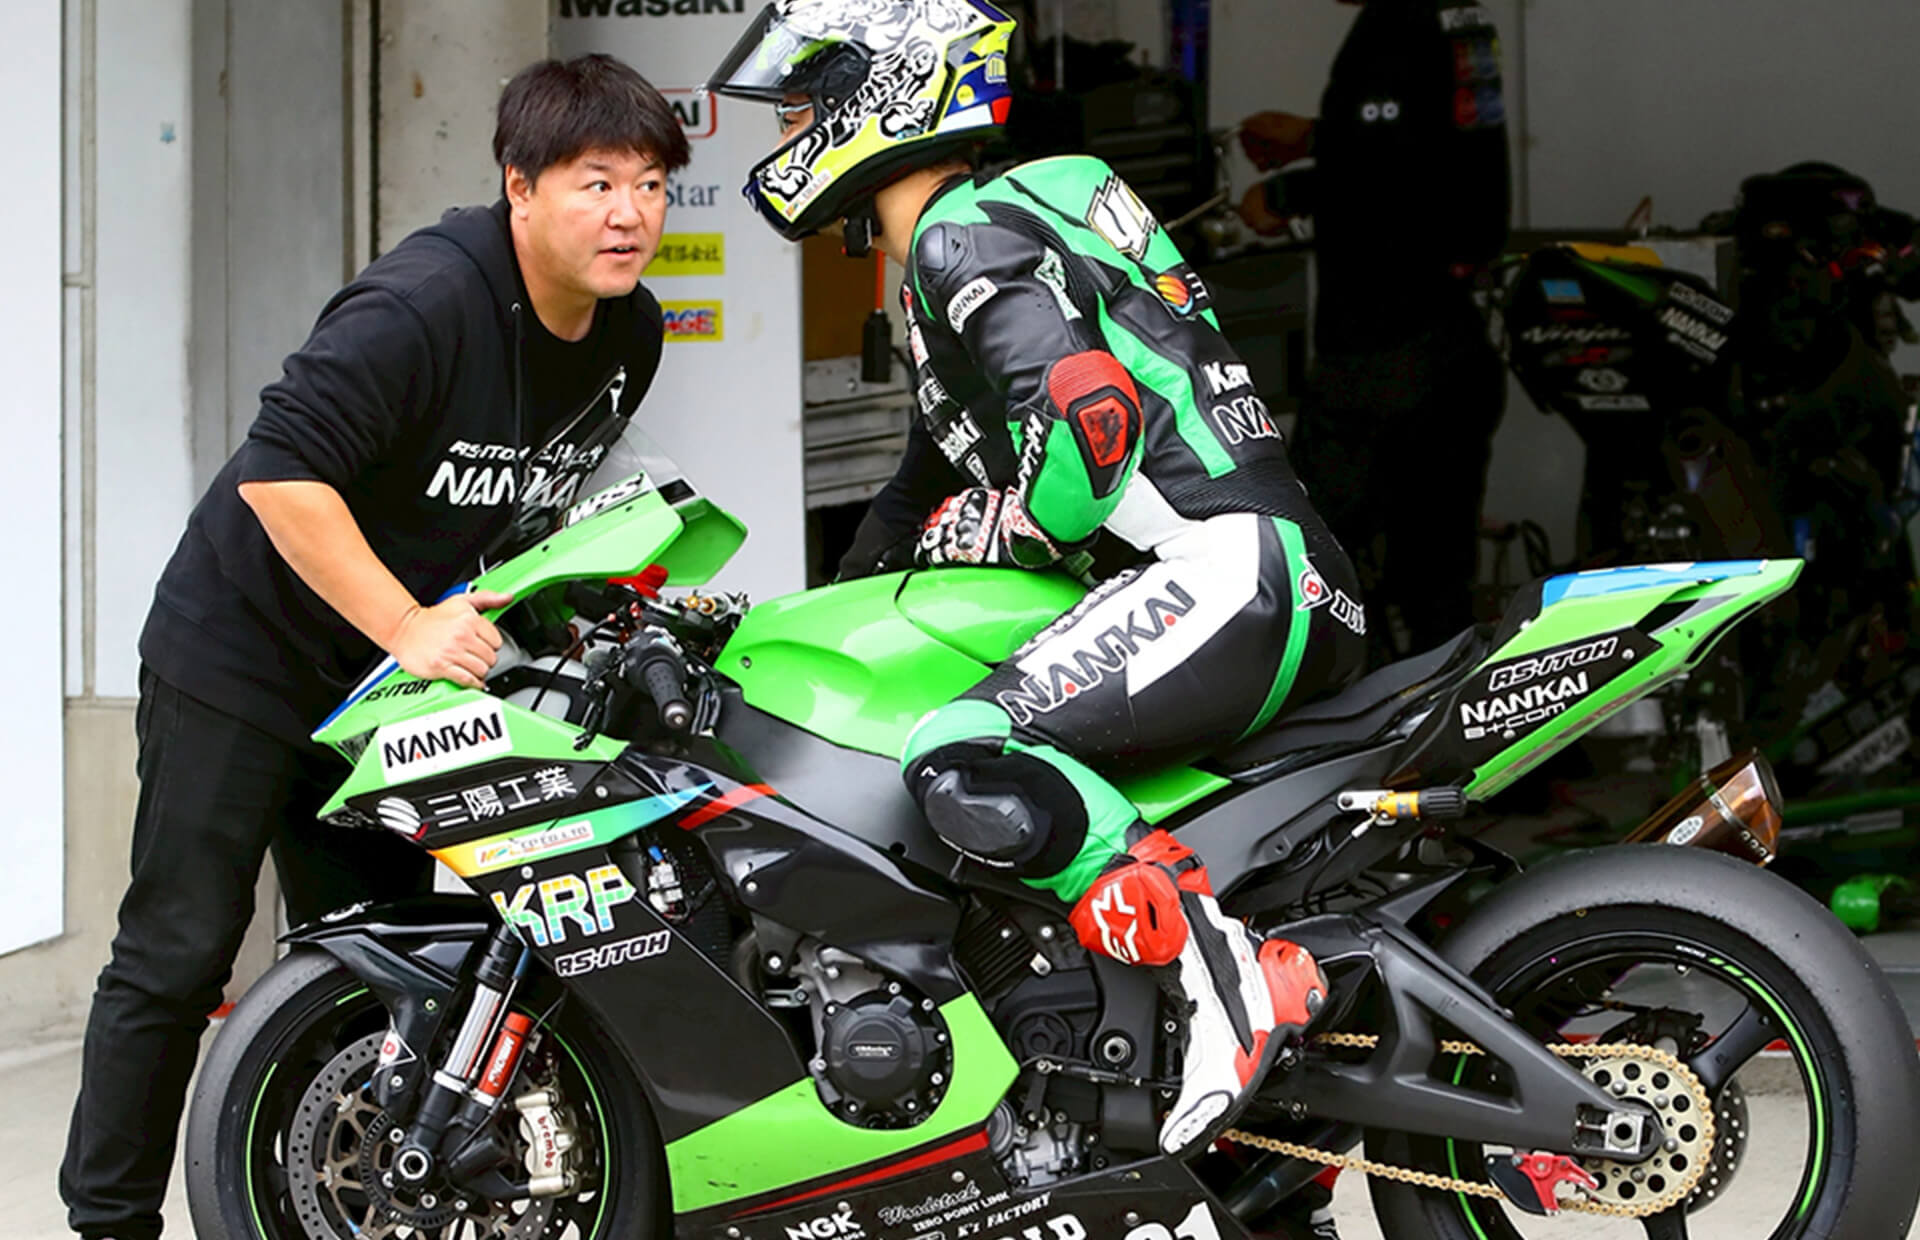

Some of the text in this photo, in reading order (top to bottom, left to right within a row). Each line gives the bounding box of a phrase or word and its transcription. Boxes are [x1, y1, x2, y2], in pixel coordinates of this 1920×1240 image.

[998, 579, 1196, 725] NANKAI
[1460, 671, 1589, 725] NANKAI
[383, 712, 503, 768] NANKAI
[427, 766, 577, 828] 三陽工業
[490, 864, 637, 947] KRP
[537, 1116, 554, 1168] brembo
[785, 1210, 861, 1240] NGK
[986, 1192, 1052, 1228] FACTORY
